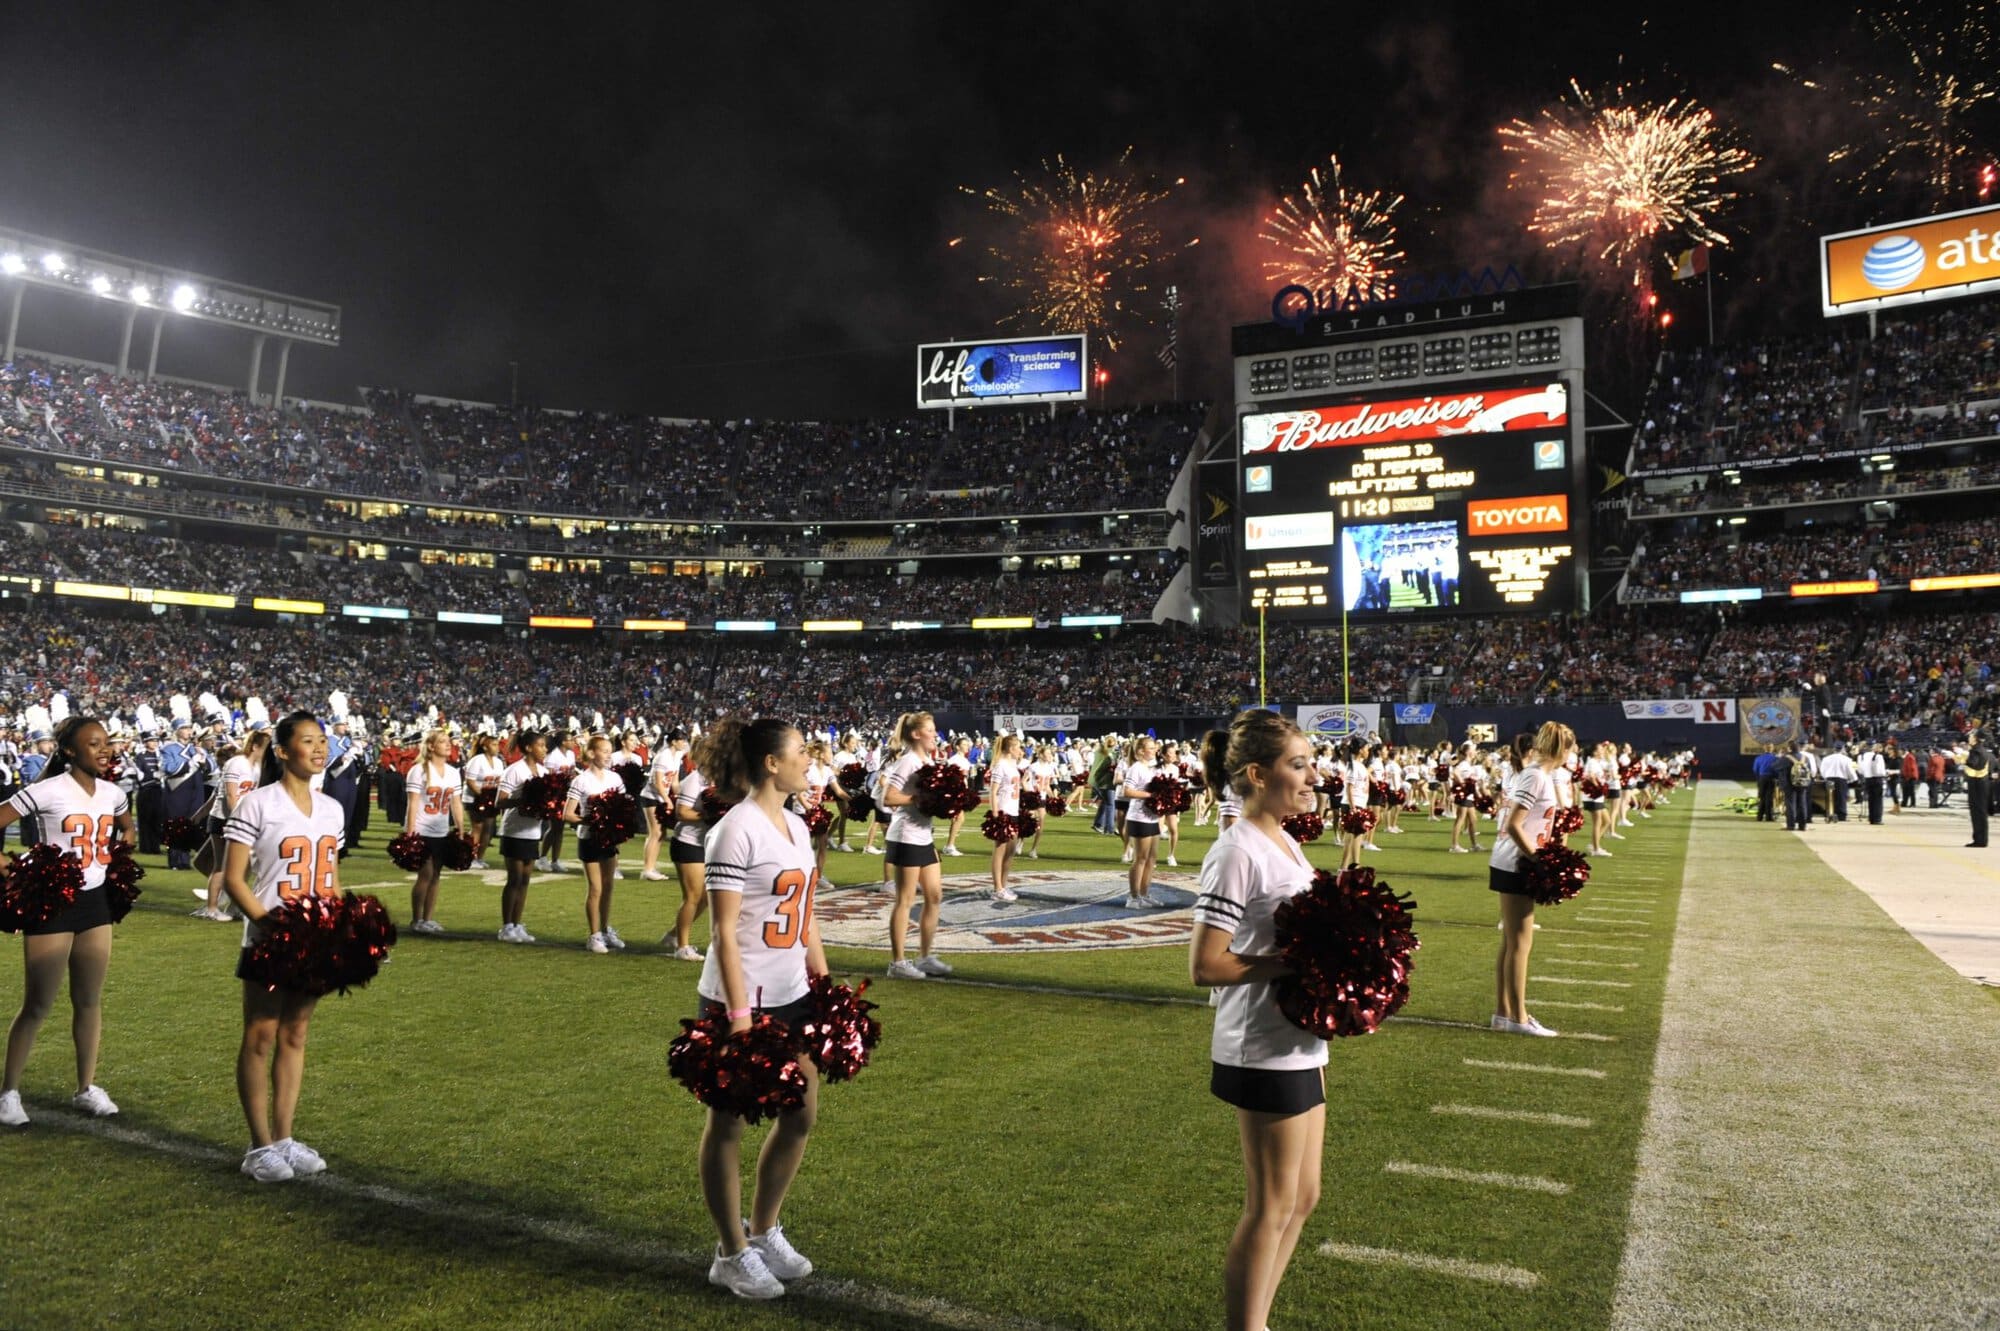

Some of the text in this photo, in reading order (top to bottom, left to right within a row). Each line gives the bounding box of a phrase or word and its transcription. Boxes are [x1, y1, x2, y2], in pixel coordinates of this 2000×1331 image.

[1323, 300, 1505, 334] STADIUM
[1008, 350, 1077, 363] Transforming
[1023, 361, 1061, 371] science
[921, 350, 976, 397] life
[960, 382, 1021, 393] technologies
[1268, 395, 1487, 452] Budweiser
[1414, 443, 1434, 457] TO
[1352, 457, 1444, 478] DR PEPPER
[1329, 470, 1475, 496] HALFTIME SHOW
[1472, 505, 1563, 528] TOYOTA
[1200, 523, 1233, 537] Sprint
[1703, 702, 1726, 721] N
